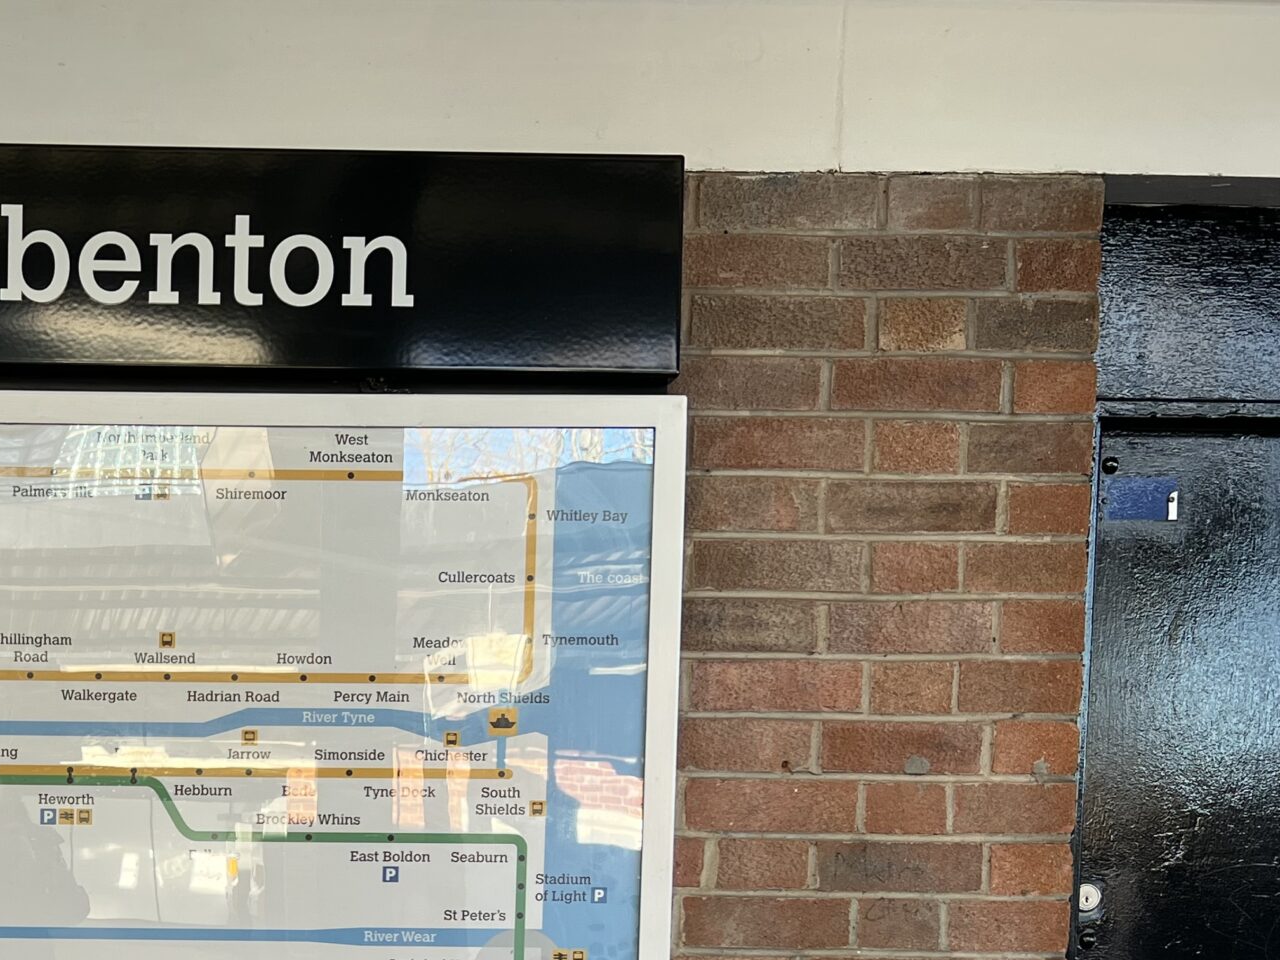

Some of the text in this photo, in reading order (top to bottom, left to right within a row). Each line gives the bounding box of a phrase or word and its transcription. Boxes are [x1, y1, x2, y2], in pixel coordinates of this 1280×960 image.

[335, 434, 368, 446] West
[310, 451, 393, 464] Monkseaton
[216, 488, 287, 501] Shiremoor
[406, 489, 489, 502] Monkseaton
[546, 509, 627, 524] Whitley Bay
[438, 571, 515, 584] Cullercoats
[542, 634, 618, 648] Tynemouth
[13, 651, 48, 662] Road
[134, 652, 195, 664] Wallsend
[277, 653, 332, 665] Howdon
[62, 689, 137, 703] Walkergate
[187, 690, 280, 703] Hadrian Road
[333, 691, 409, 705] Percy Main
[458, 691, 550, 704] North Shields
[302, 712, 375, 725] River Tyne
[227, 749, 271, 760] Jarrow
[314, 749, 385, 761] Simonside
[415, 750, 488, 762] Chichester
[174, 784, 232, 797] Hebburn
[364, 786, 435, 801] Tyne Dock
[481, 787, 520, 799] South
[38, 793, 94, 806] Heworth
[475, 804, 525, 816] Shields
[257, 814, 360, 828] Brockley Whins
[350, 851, 430, 863] East Boldon
[451, 852, 508, 863] Seaburn
[535, 874, 591, 886] Stadium
[535, 891, 586, 905] of Light
[443, 910, 458, 921] St
[364, 931, 437, 942] River Wear
